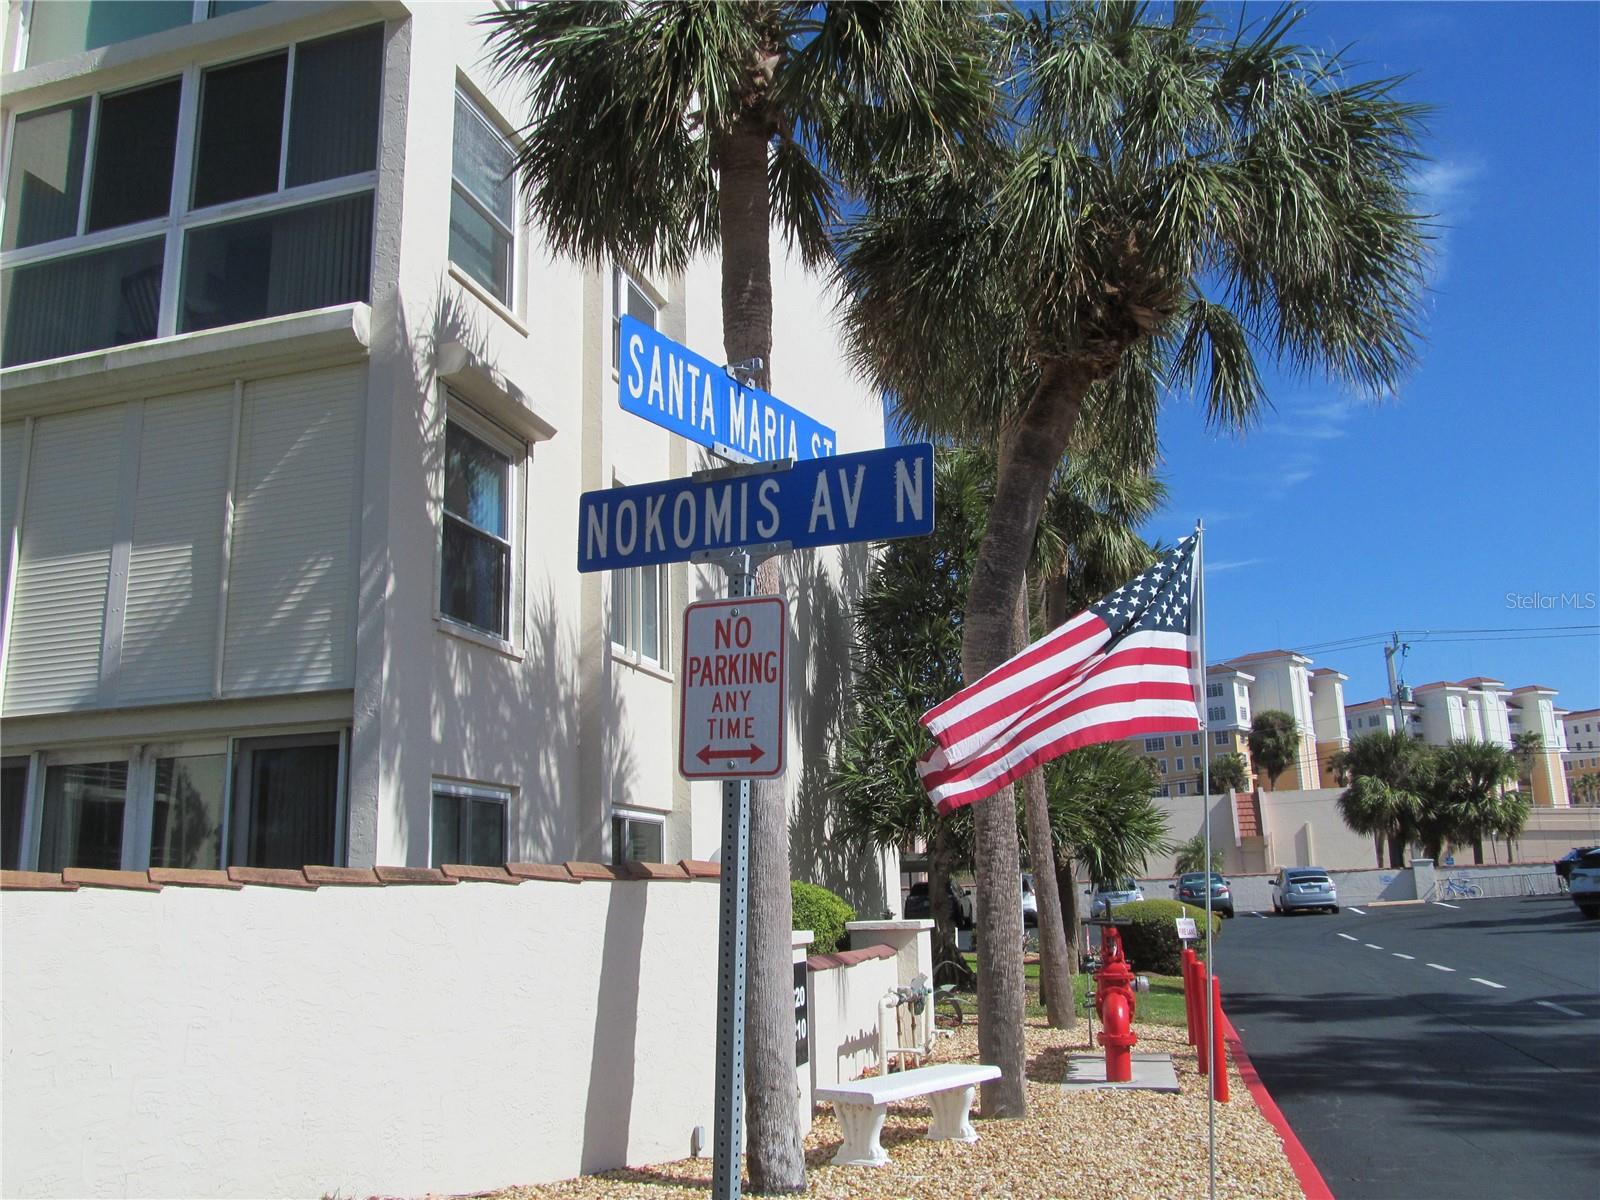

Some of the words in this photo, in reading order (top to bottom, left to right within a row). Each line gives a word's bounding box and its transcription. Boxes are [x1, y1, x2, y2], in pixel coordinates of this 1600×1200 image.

[627, 334, 715, 436] SANTA
[729, 386, 798, 462] MARIA
[586, 479, 780, 560] NOKOMIS
[808, 464, 866, 533] AV
[895, 457, 924, 523] N
[714, 616, 752, 650] NO
[688, 651, 778, 688] PARKING
[711, 690, 752, 713] ANY
[707, 717, 755, 741] TIME
